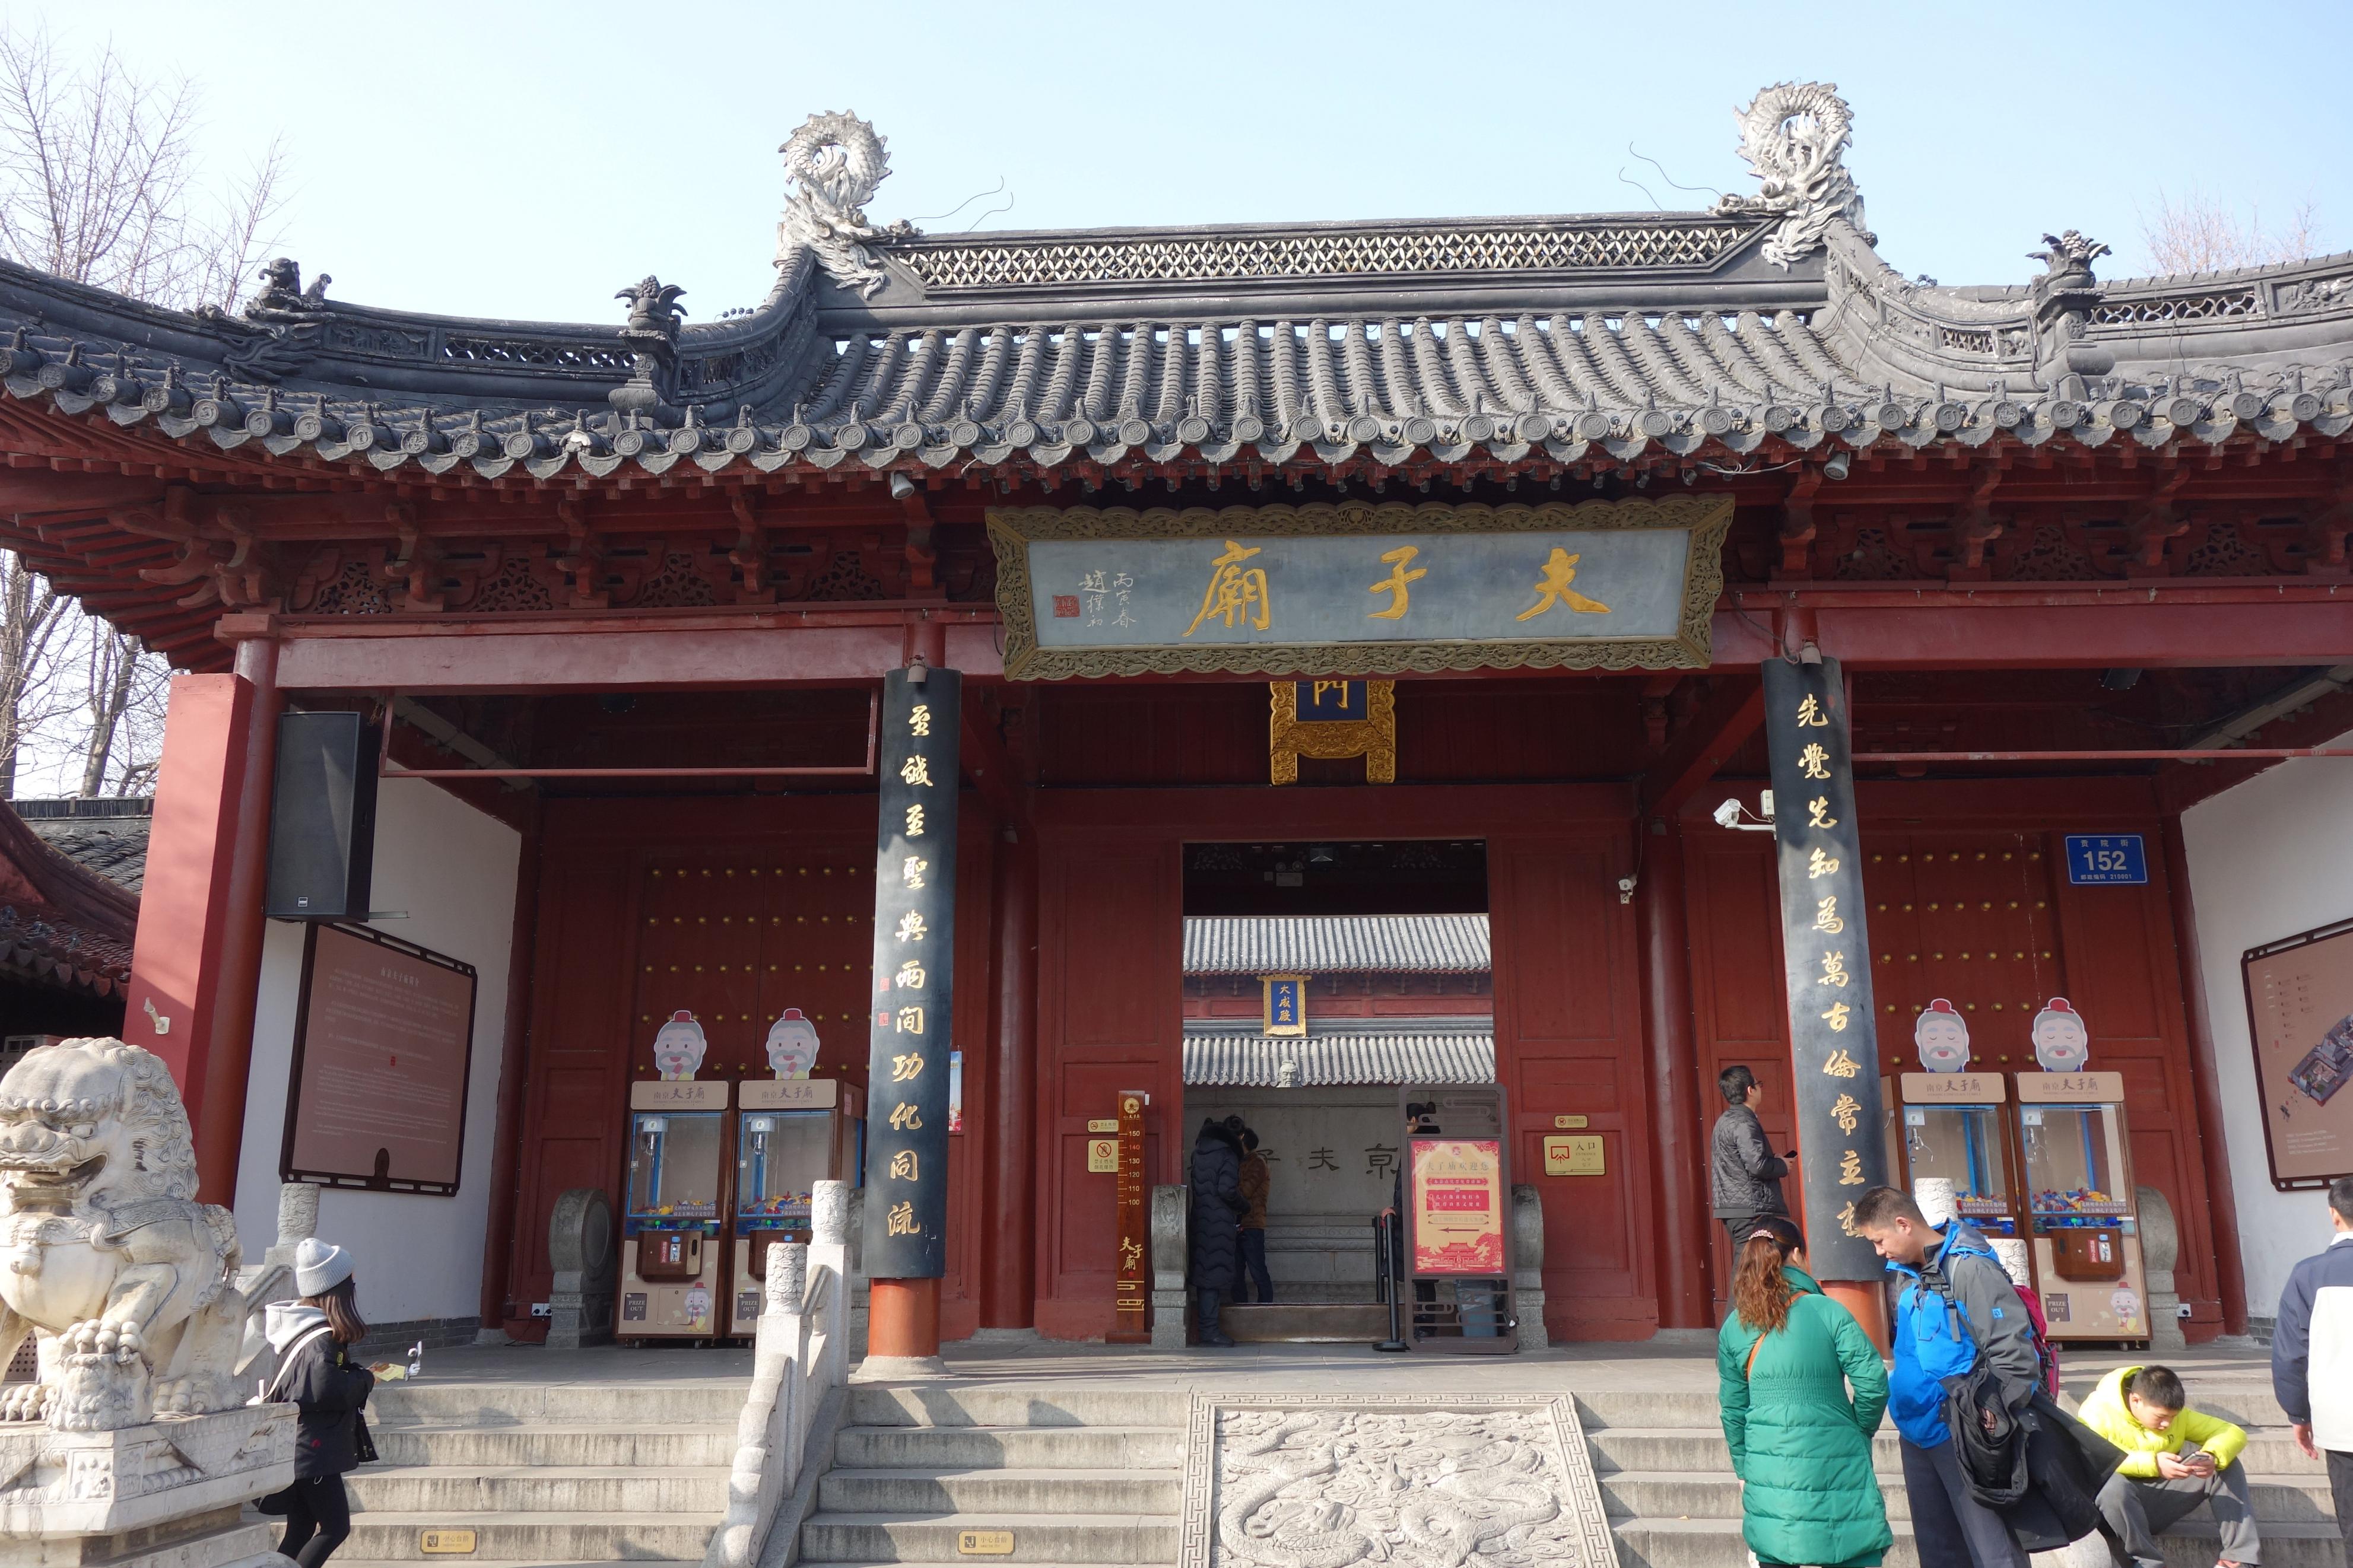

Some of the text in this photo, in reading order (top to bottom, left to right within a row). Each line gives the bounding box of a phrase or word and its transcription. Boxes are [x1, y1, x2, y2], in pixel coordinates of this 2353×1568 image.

[1184, 540, 1611, 637] 夫子廟
[2083, 851, 2127, 871] 152
[1278, 984, 1292, 1022] 大成殿
[1576, 1142, 1595, 1150] 入口
